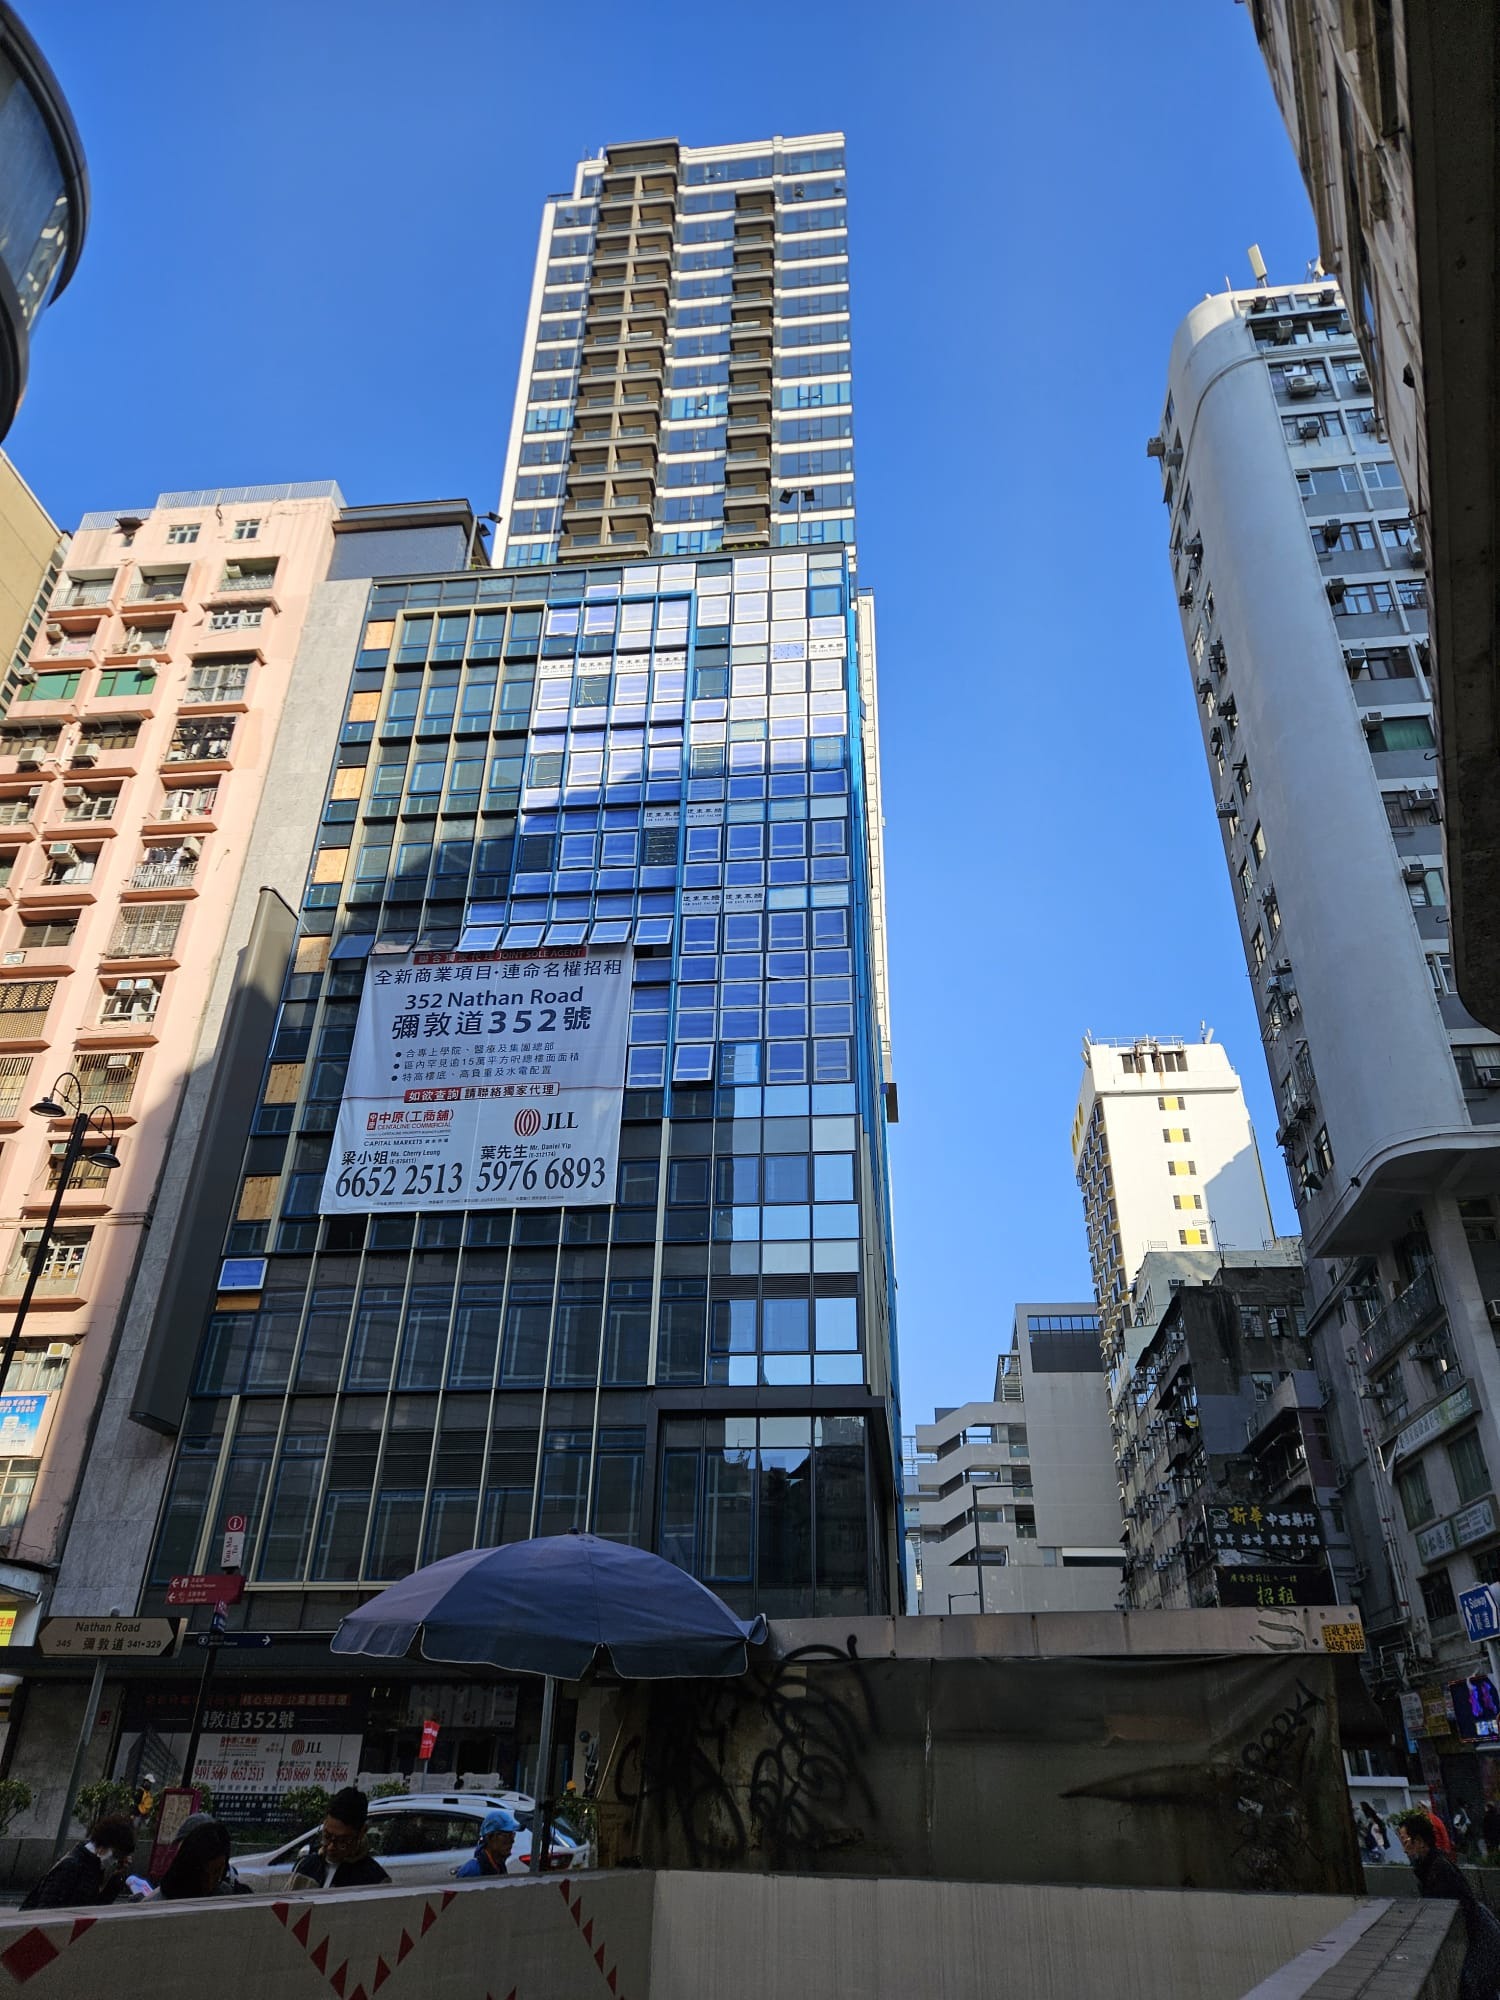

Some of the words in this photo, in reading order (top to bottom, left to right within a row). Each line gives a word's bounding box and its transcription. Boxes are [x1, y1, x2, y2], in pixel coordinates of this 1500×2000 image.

[498, 951, 523, 961] JOINT
[526, 950, 548, 959] SOLE
[551, 949, 581, 958] AGENT
[405, 994, 443, 1010] 352
[448, 990, 525, 1008] Nathan
[530, 986, 584, 1005] Road
[392, 1006, 592, 1039] 彌敦道352號
[408, 1089, 459, 1102] 如欲查詢
[464, 1084, 554, 1099] 請聯絡獨家代理
[379, 1109, 454, 1124] 中原(工商舖)
[542, 1111, 578, 1131] JLL
[411, 1121, 451, 1129] COMMERCIAL
[393, 1138, 422, 1146] MARKETS
[341, 1150, 388, 1166] 梁小姐
[403, 1150, 423, 1158] Cherry
[480, 1144, 528, 1160] 葉先生
[335, 1165, 397, 1197] 6652
[402, 1162, 463, 1195] 2513
[476, 1158, 538, 1192] 5976
[544, 1156, 606, 1190] 6893
[1257, 1585, 1297, 1606] 招租
[1469, 1597, 1487, 1609] Subway
[75, 1622, 112, 1633] Nathan
[115, 1622, 142, 1633] Road
[56, 1639, 72, 1648] 345
[83, 1638, 124, 1651] 彌敦道
[305, 1741, 323, 1754] JLL
[194, 1766, 210, 1780] 9491
[230, 1766, 246, 1781] 6652
[248, 1766, 264, 1781] 2513
[313, 1767, 330, 1781] 9567
